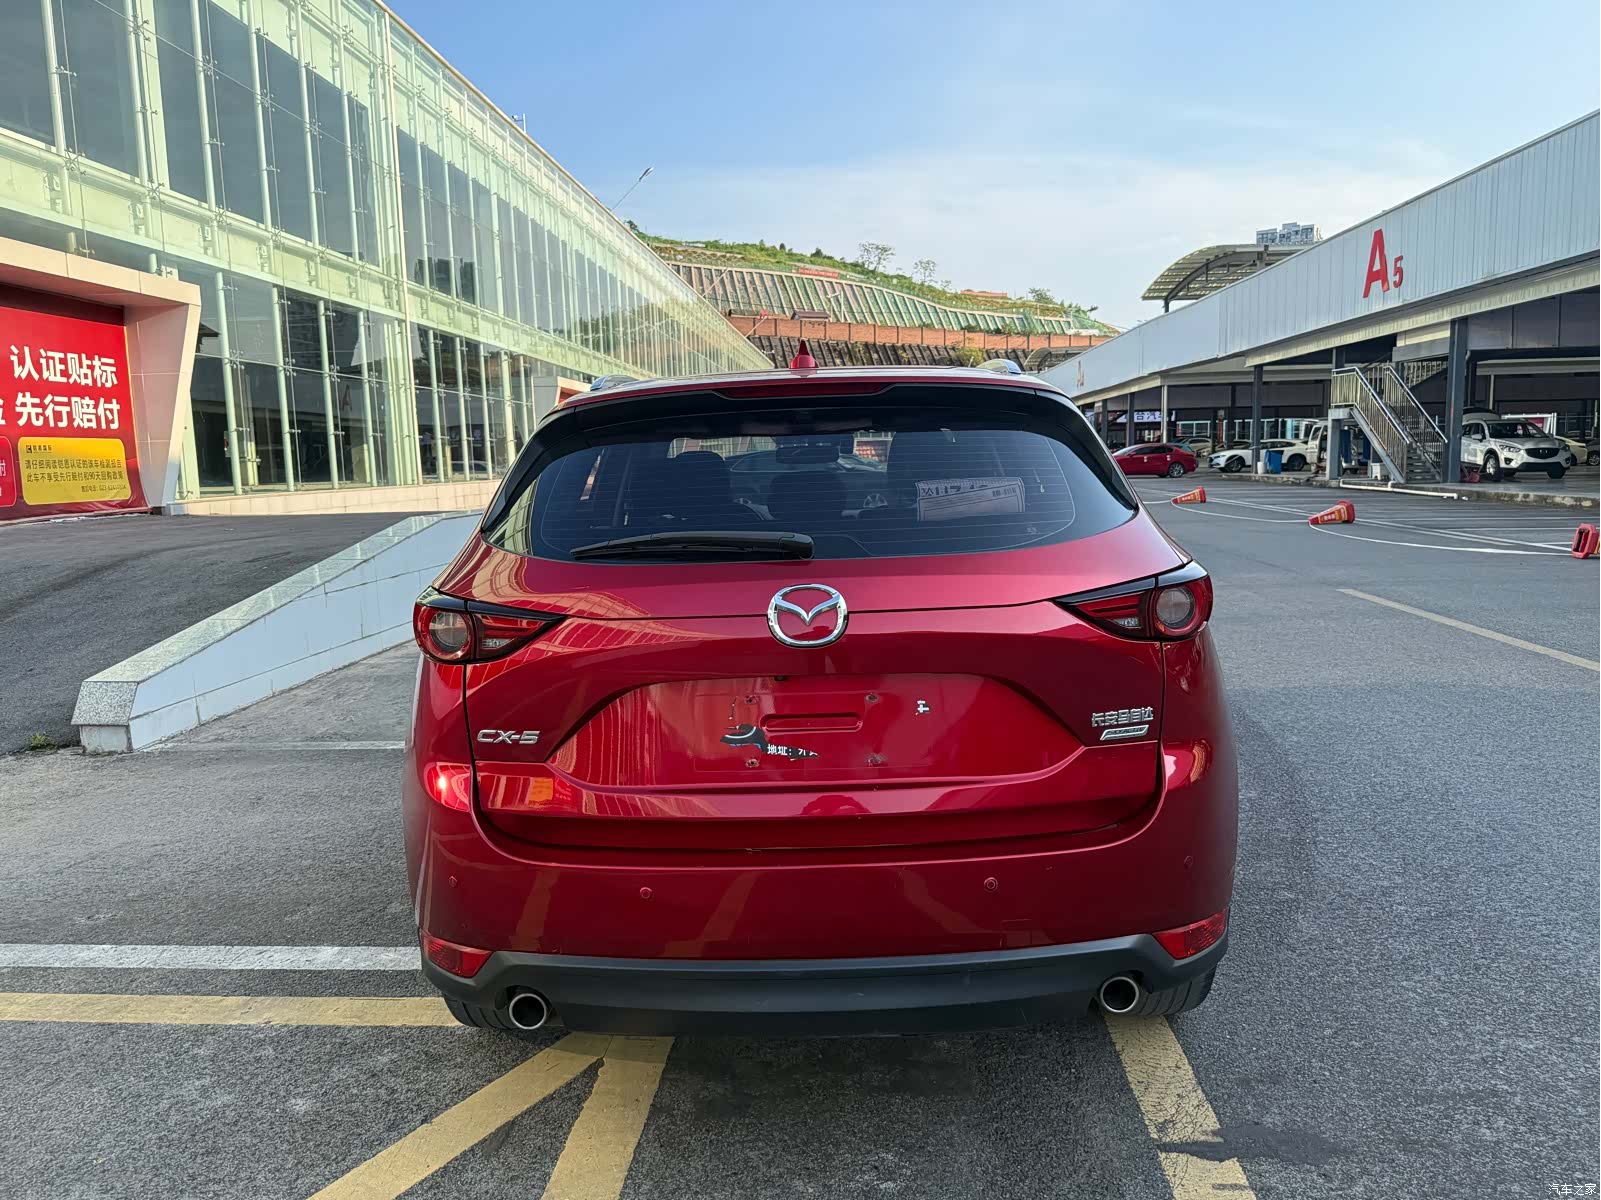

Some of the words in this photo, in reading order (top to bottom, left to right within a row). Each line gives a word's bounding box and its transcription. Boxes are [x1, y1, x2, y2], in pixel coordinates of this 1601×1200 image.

[1363, 228, 1404, 298] A5
[10, 344, 118, 388] 认证贴标
[15, 392, 120, 429] 先行赔付
[1091, 706, 1153, 727] 长安马自达
[477, 729, 540, 744] CX-5
